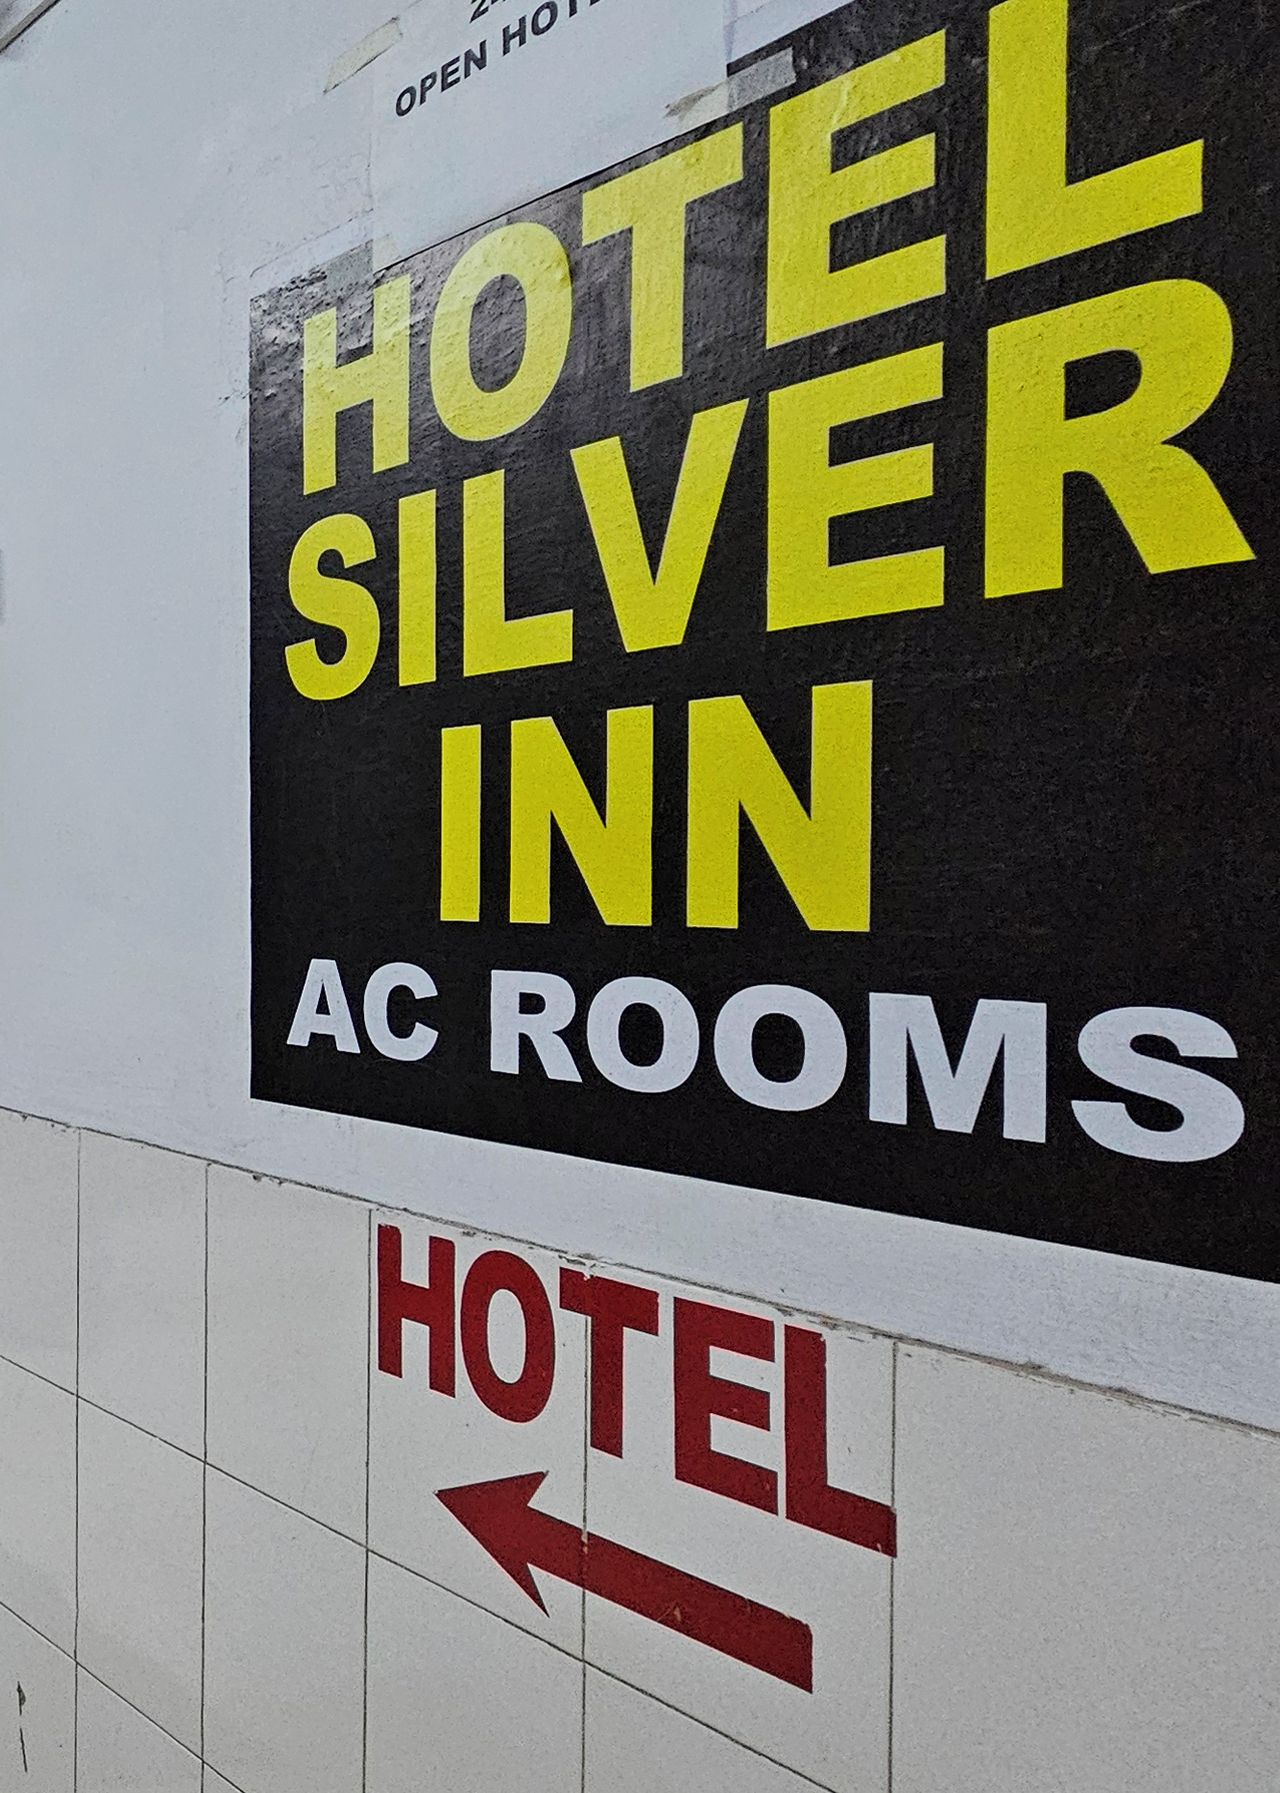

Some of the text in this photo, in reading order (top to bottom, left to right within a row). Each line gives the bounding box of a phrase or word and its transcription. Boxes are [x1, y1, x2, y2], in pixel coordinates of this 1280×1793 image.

[395, 39, 488, 117] OPEN
[302, 0, 1205, 496] HOTEL
[284, 277, 1257, 701] SILVER
[440, 680, 873, 932] INN
[286, 958, 1247, 1163] AC ROOMS
[376, 1224, 898, 1557] HOTEL
